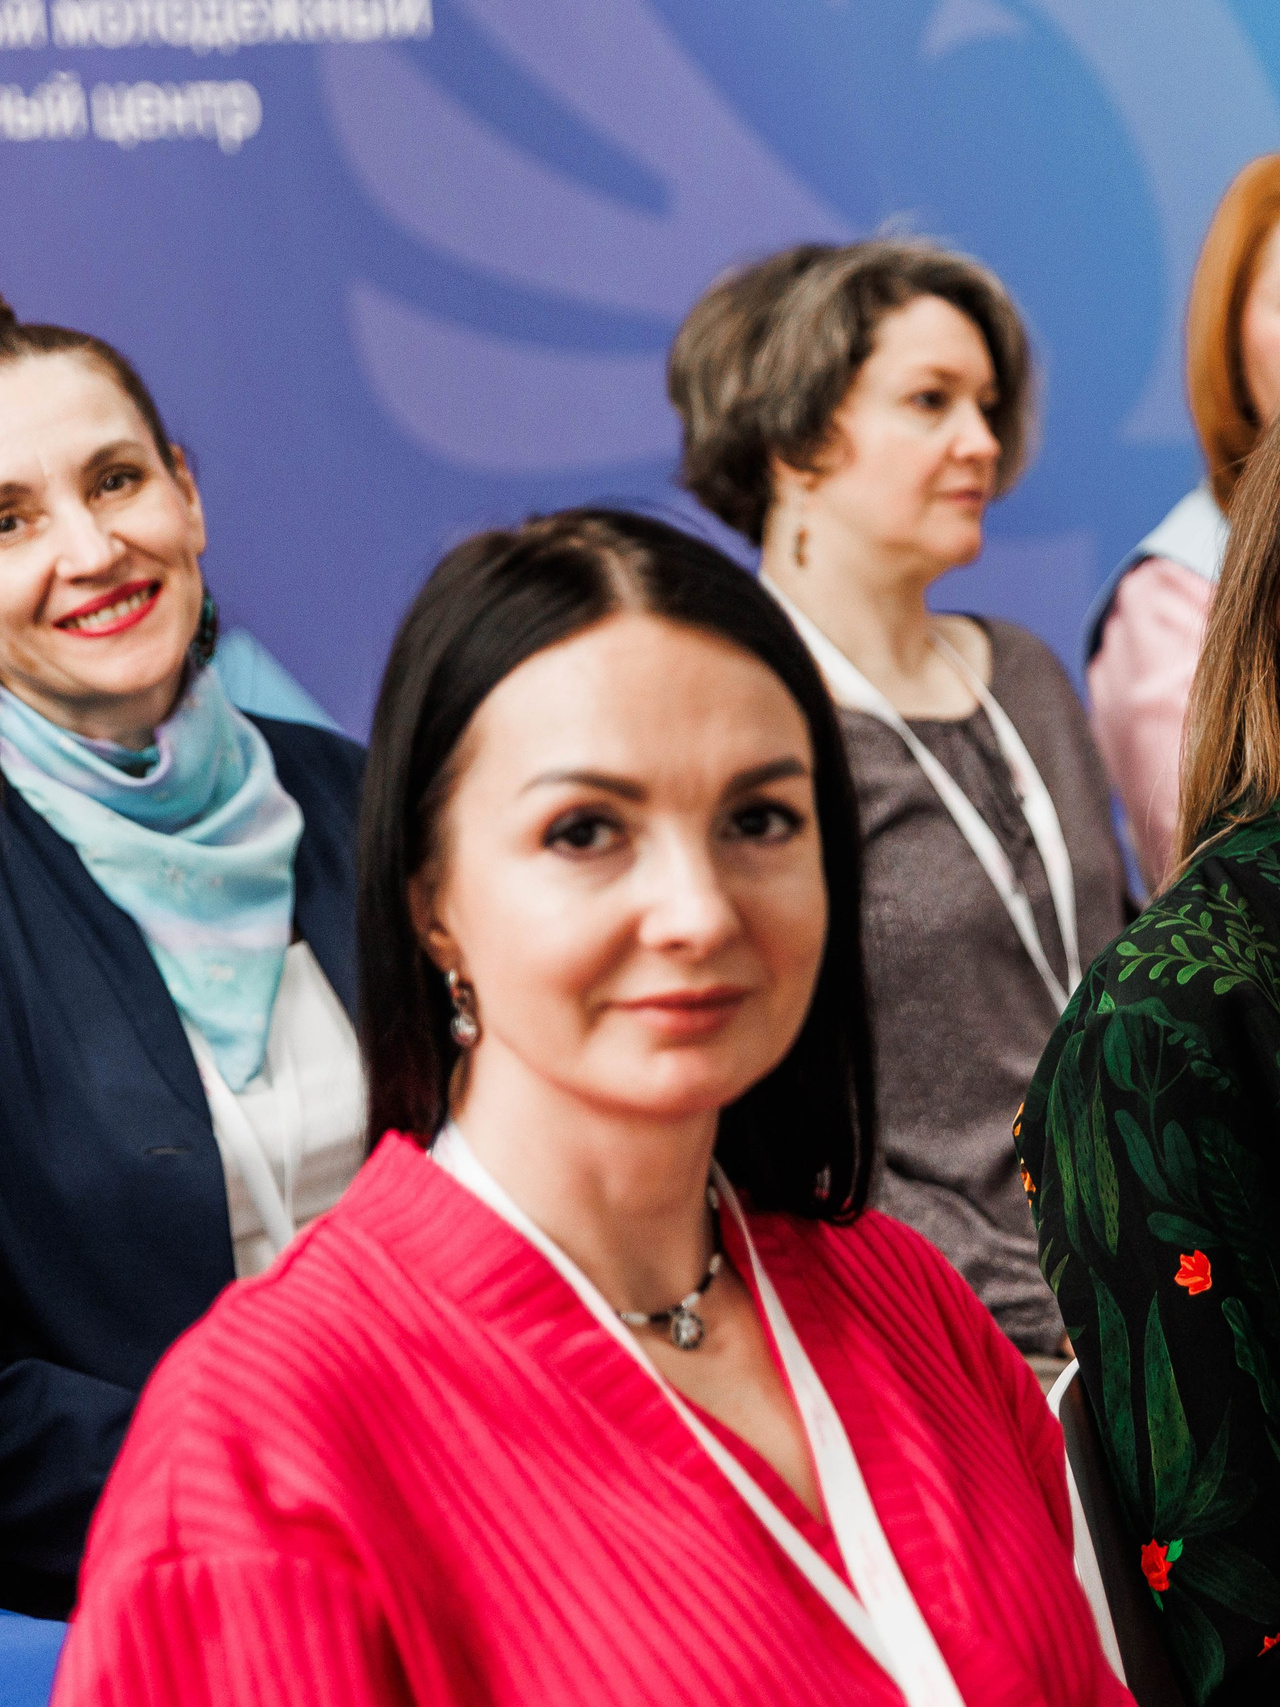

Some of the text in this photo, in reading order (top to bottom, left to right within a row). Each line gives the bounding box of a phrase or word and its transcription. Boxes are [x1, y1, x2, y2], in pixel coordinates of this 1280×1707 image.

[52, 0, 433, 55] молодежный
[0, 71, 262, 154] ый центр
